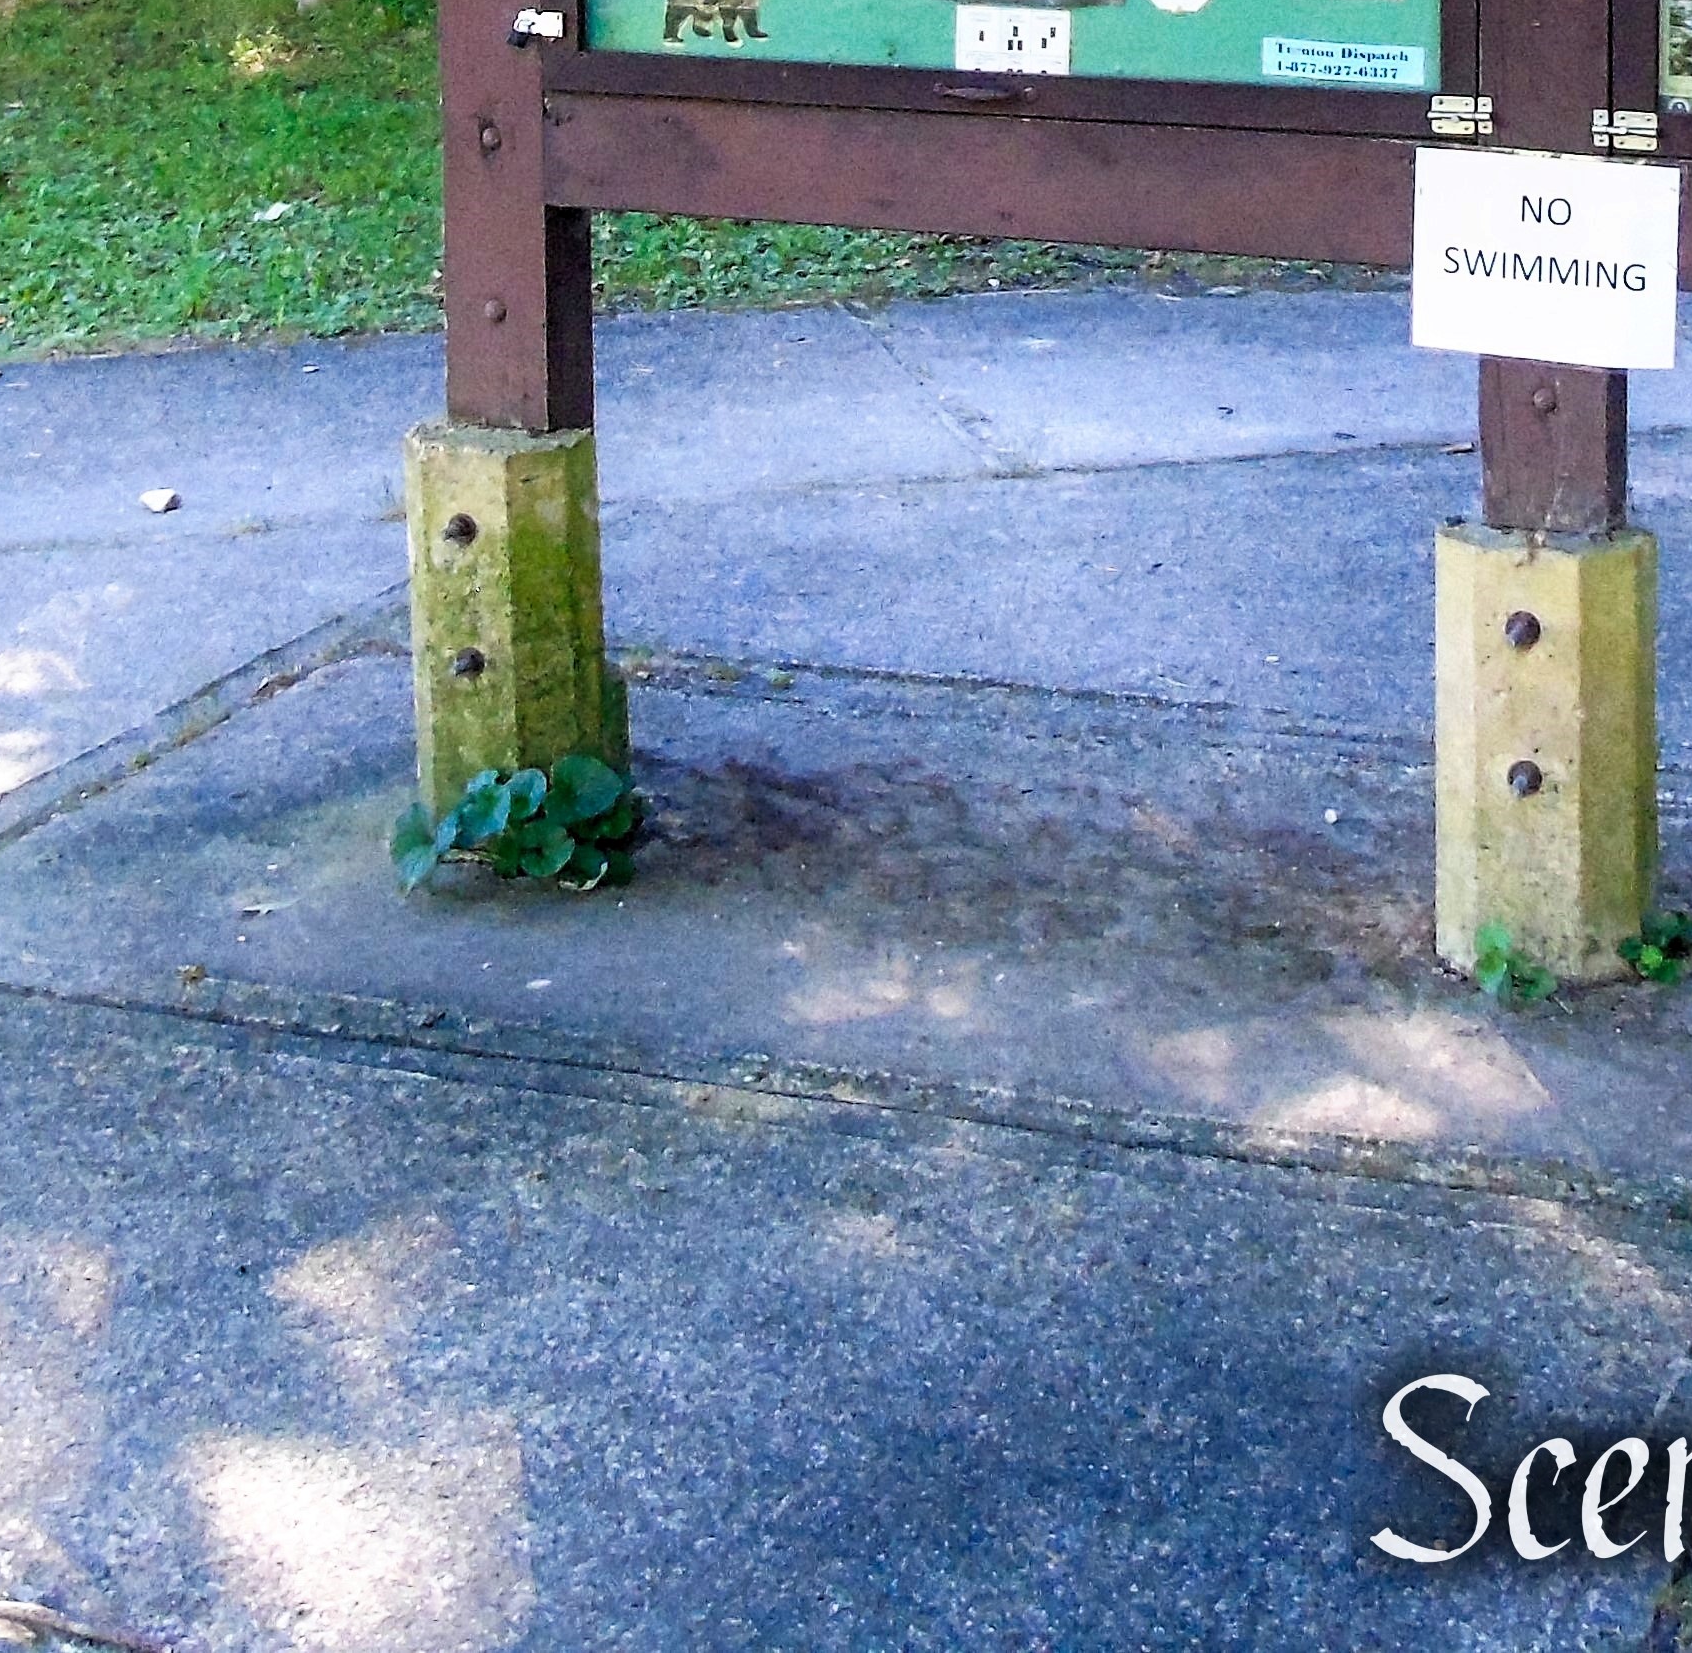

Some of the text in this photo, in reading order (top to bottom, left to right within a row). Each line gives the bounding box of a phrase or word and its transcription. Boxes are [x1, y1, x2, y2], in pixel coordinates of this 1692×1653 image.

[1341, 47, 1410, 63] Dispatch
[1277, 60, 1399, 80] 1-877-927-6337
[1520, 194, 1572, 226] NO
[1443, 245, 1647, 292] SWIMMING
